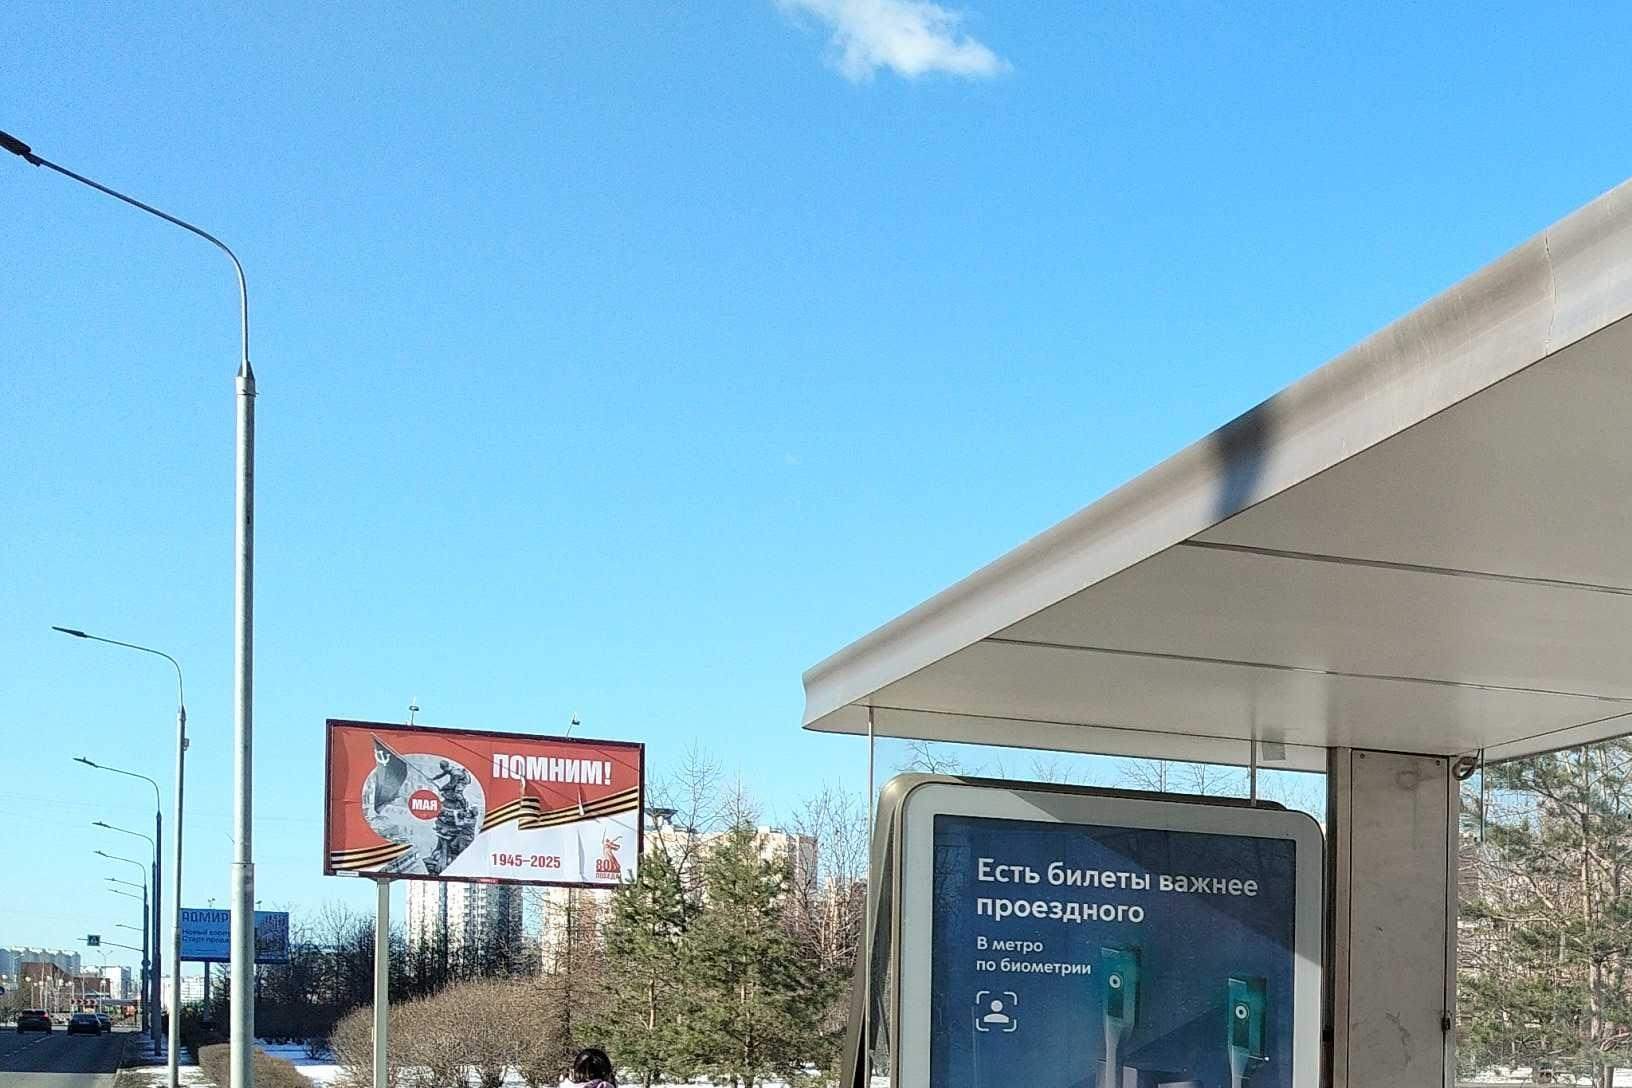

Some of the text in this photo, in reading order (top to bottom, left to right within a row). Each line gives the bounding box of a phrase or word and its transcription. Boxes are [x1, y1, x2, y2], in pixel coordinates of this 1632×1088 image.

[492, 753, 612, 786] ПОМНИМ!
[411, 798, 438, 812] МАЯ
[977, 857, 1259, 897] Есть билеты важнее
[182, 911, 229, 923] АДМИР
[976, 897, 1145, 923] проездного
[976, 936, 1043, 955] В метро
[976, 957, 1091, 978] по биометрии
